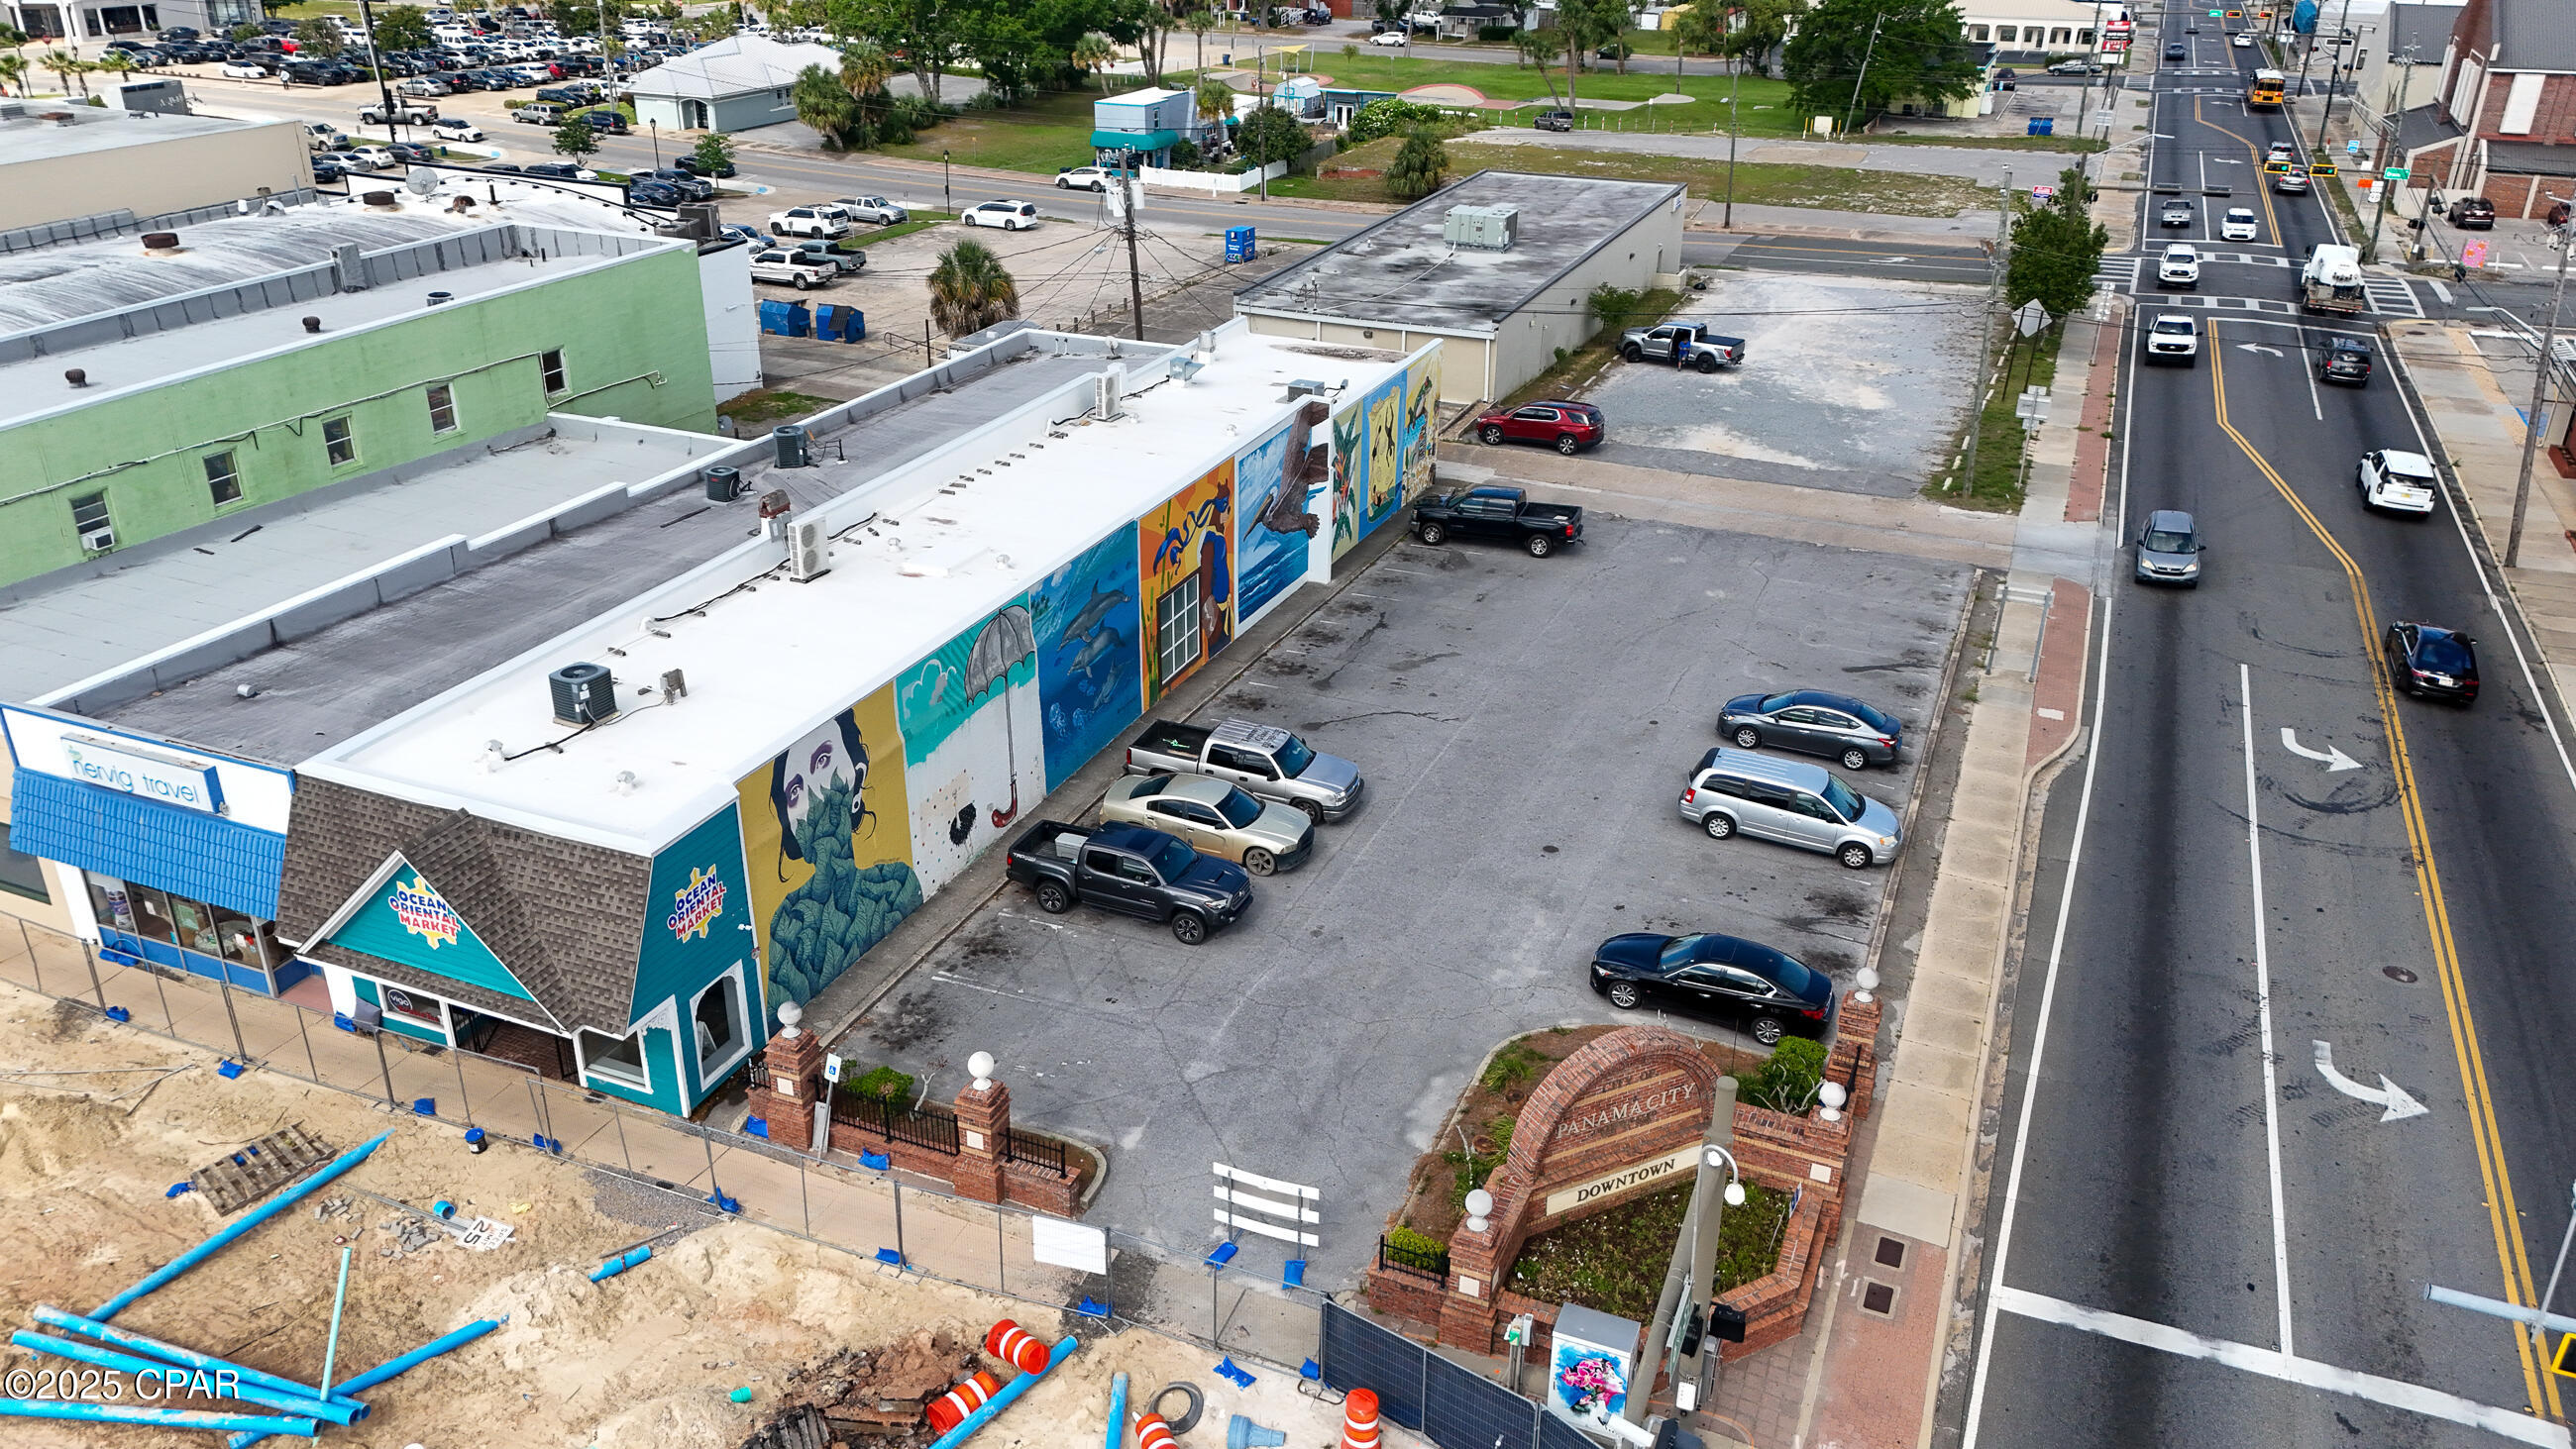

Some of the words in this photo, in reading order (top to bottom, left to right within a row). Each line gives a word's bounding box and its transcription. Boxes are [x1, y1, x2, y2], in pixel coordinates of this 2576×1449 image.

[72, 760, 134, 793] nervig
[143, 773, 199, 803] travel
[398, 890, 446, 911] OCEAN
[668, 882, 725, 928] ORIENTAL
[676, 874, 716, 911] OCEAN
[389, 897, 459, 929] ORIENTAL
[399, 913, 456, 937] MARKET
[677, 894, 722, 938] MARKET
[390, 994, 409, 1006] vigo
[1556, 1099, 1643, 1139] PANAMA
[1646, 1082, 1696, 1110] CITY
[1576, 1158, 1675, 1202] DOWNTOWN
[464, 1219, 491, 1245] 25
